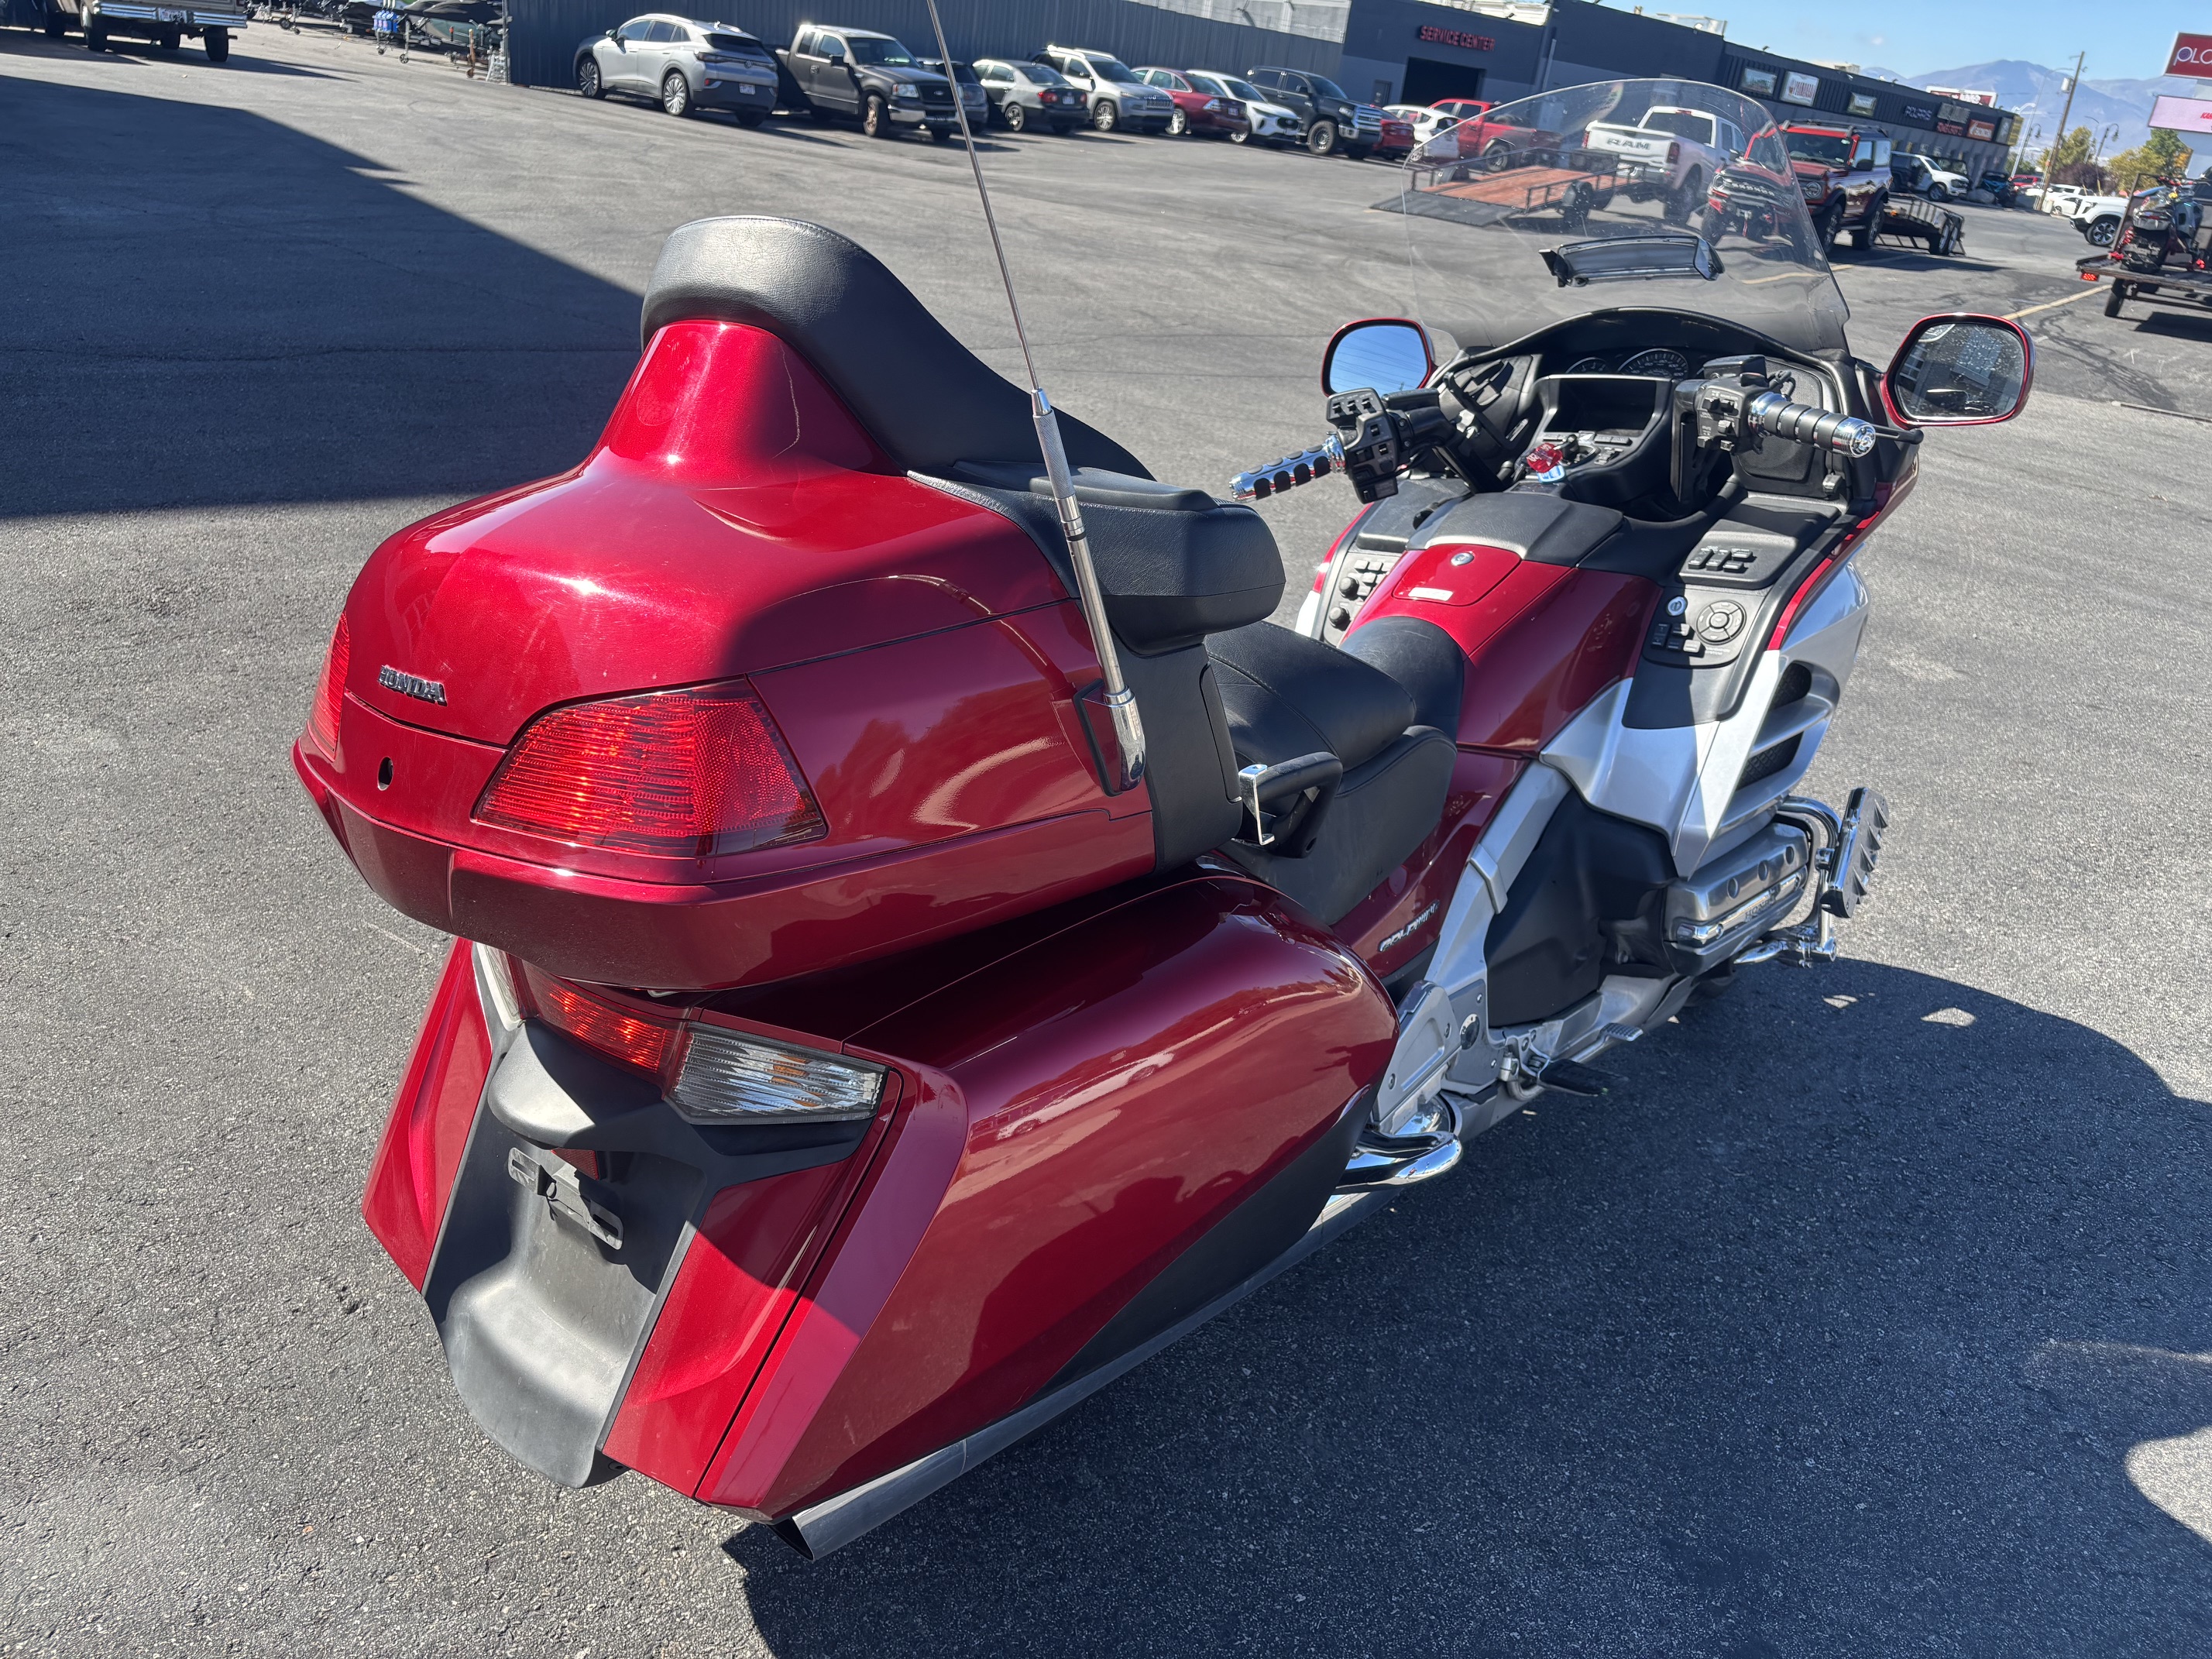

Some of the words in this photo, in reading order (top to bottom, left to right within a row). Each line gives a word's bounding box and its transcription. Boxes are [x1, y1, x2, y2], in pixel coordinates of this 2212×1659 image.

[1420, 25, 1459, 46] SERVICE
[1460, 33, 1496, 51] CENTER
[1606, 138, 1651, 151] RAM
[378, 665, 447, 705] HONDA
